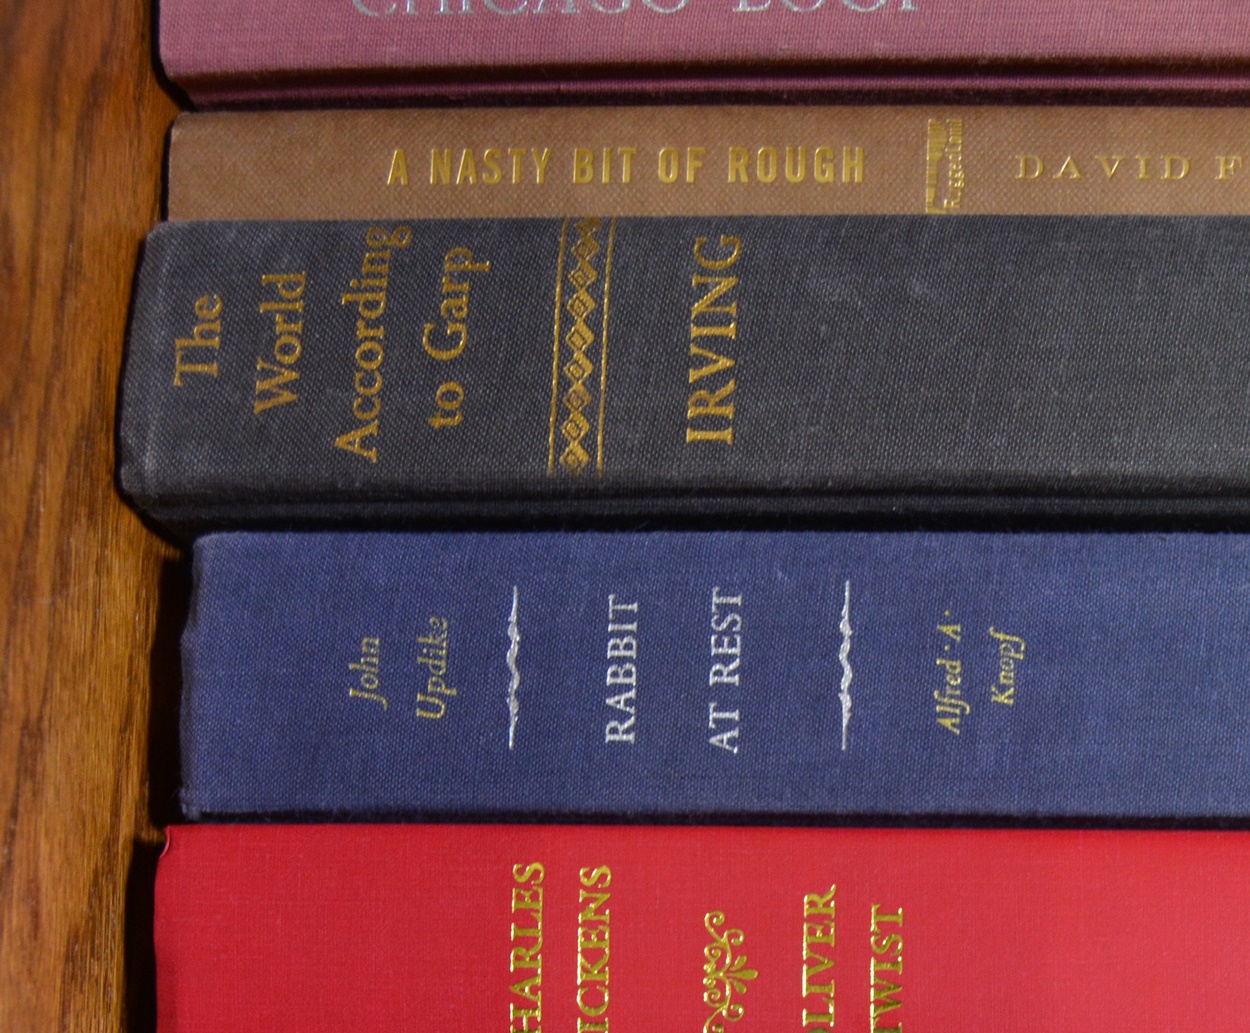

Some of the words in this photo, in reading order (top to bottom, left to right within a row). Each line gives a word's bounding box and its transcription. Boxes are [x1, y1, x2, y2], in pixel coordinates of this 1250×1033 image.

[387, 148, 409, 185] A
[430, 147, 550, 185] NASTY
[572, 146, 638, 184] BIT
[656, 147, 707, 183] OF
[726, 146, 866, 184] ROUGH
[1014, 154, 1192, 182] DAVID
[172, 292, 223, 387] The
[252, 269, 307, 415] World
[333, 225, 413, 463] According
[421, 245, 491, 361] Garp
[685, 233, 742, 446] IRVING
[426, 381, 464, 429] to
[348, 635, 388, 711] John
[415, 615, 450, 721] Updike
[604, 594, 639, 746] RABBIT
[708, 586, 743, 688] REST
[988, 625, 1027, 707] Knopf
[707, 700, 740, 754] AT
[933, 657, 972, 736] Alfred
